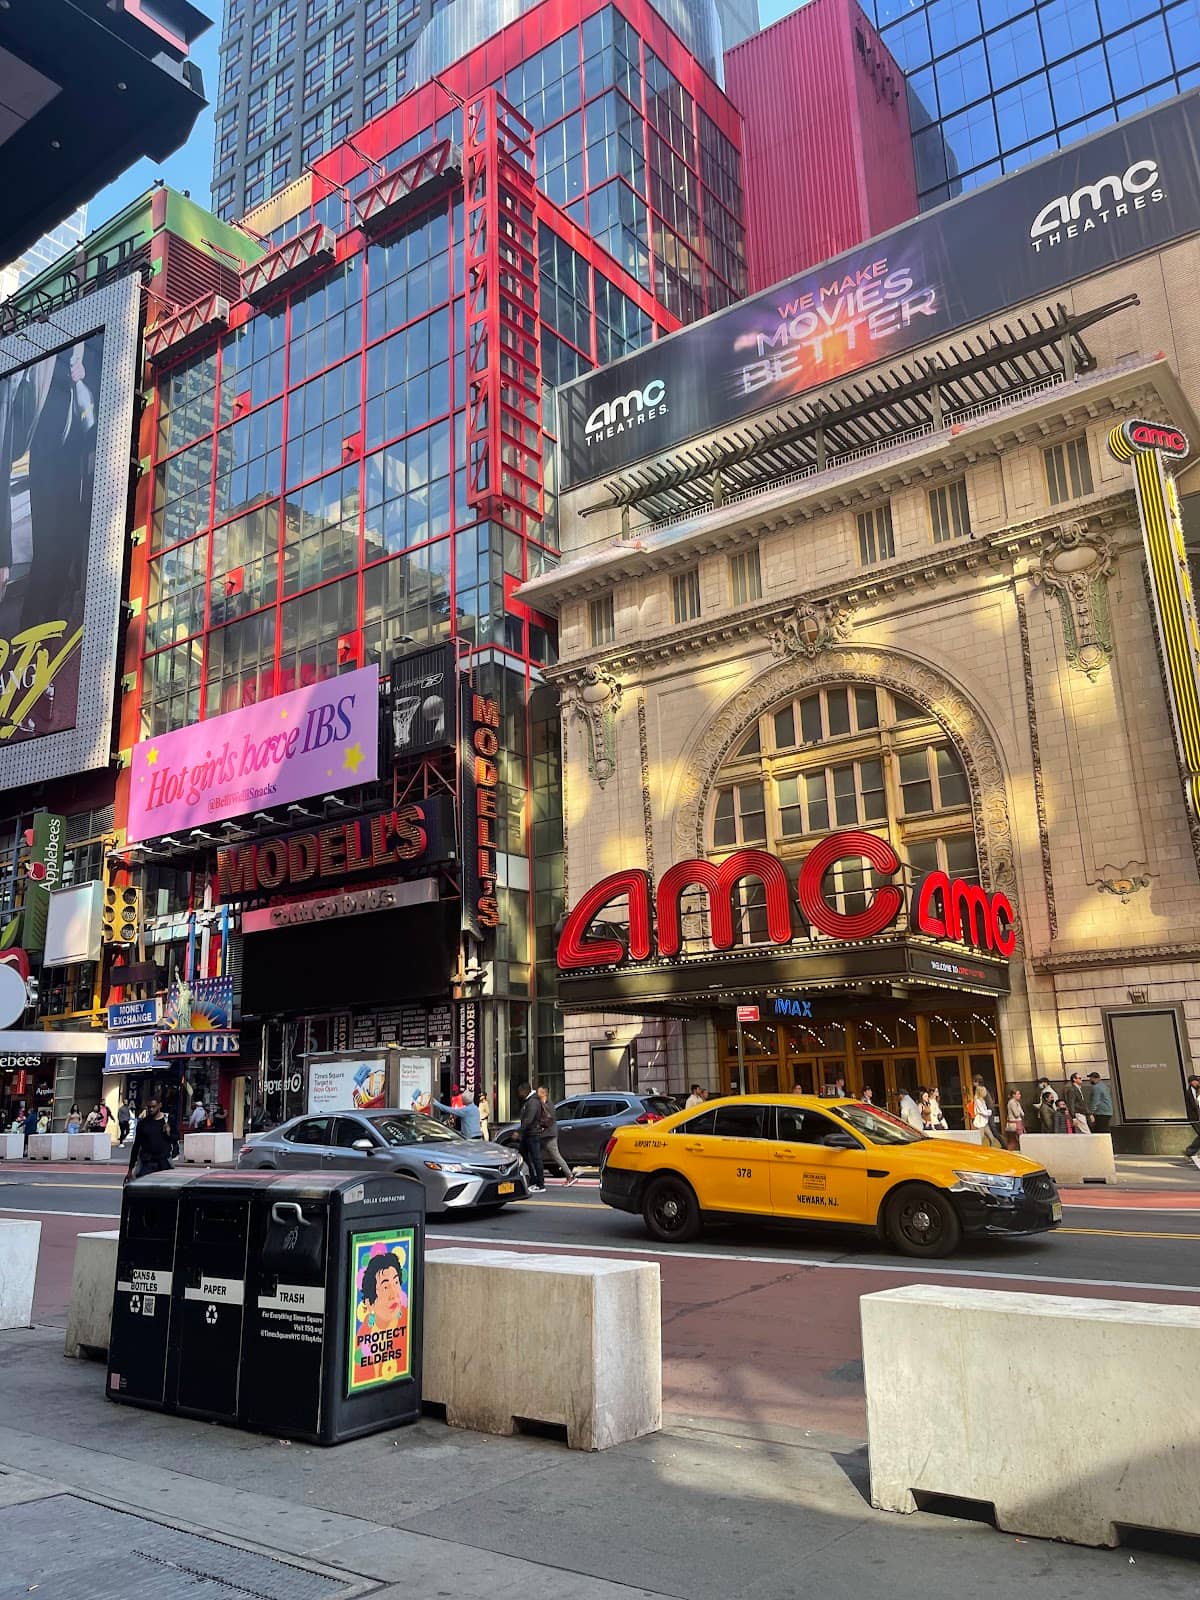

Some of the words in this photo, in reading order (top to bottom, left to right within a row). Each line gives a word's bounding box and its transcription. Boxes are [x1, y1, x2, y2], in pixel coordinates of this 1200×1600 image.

[1031, 160, 1159, 238] amc
[1032, 189, 1164, 252] THEATRES
[777, 292, 815, 318] WE
[819, 258, 889, 301] MAKE
[756, 268, 913, 357] MOVIES
[741, 287, 938, 394] BETTER
[585, 379, 666, 435] amc
[585, 403, 668, 447] THEATRES
[1133, 426, 1185, 451] amc
[145, 766, 189, 812] Hot
[186, 742, 238, 808] girls
[238, 727, 300, 777] have
[300, 694, 356, 755] IBS
[39, 818, 61, 892] Applebee's
[216, 804, 428, 895] MODELL'S
[556, 830, 904, 970] amc
[917, 870, 1016, 958] amc
[120, 1003, 145, 1015] MONEY
[775, 998, 813, 1018] IMAX
[113, 1012, 152, 1026] EXCHANGE
[117, 1036, 145, 1051] MONEY
[192, 1033, 240, 1053] GIFTS
[466, 1002, 476, 1093] SHOWSTOPPE
[109, 1051, 151, 1067] EXCHANGE
[736, 1167, 752, 1178] 378
[379, 1195, 405, 1203] COMPACTOR
[133, 1270, 150, 1281] CANS
[150, 1272, 156, 1281] &
[130, 1281, 158, 1292] BOTTLES
[203, 1284, 227, 1296] PAPER
[279, 1291, 305, 1304] TRASH
[357, 1326, 407, 1347] PROTECT
[370, 1339, 393, 1354] OUR
[360, 1348, 402, 1368] ELDERS
